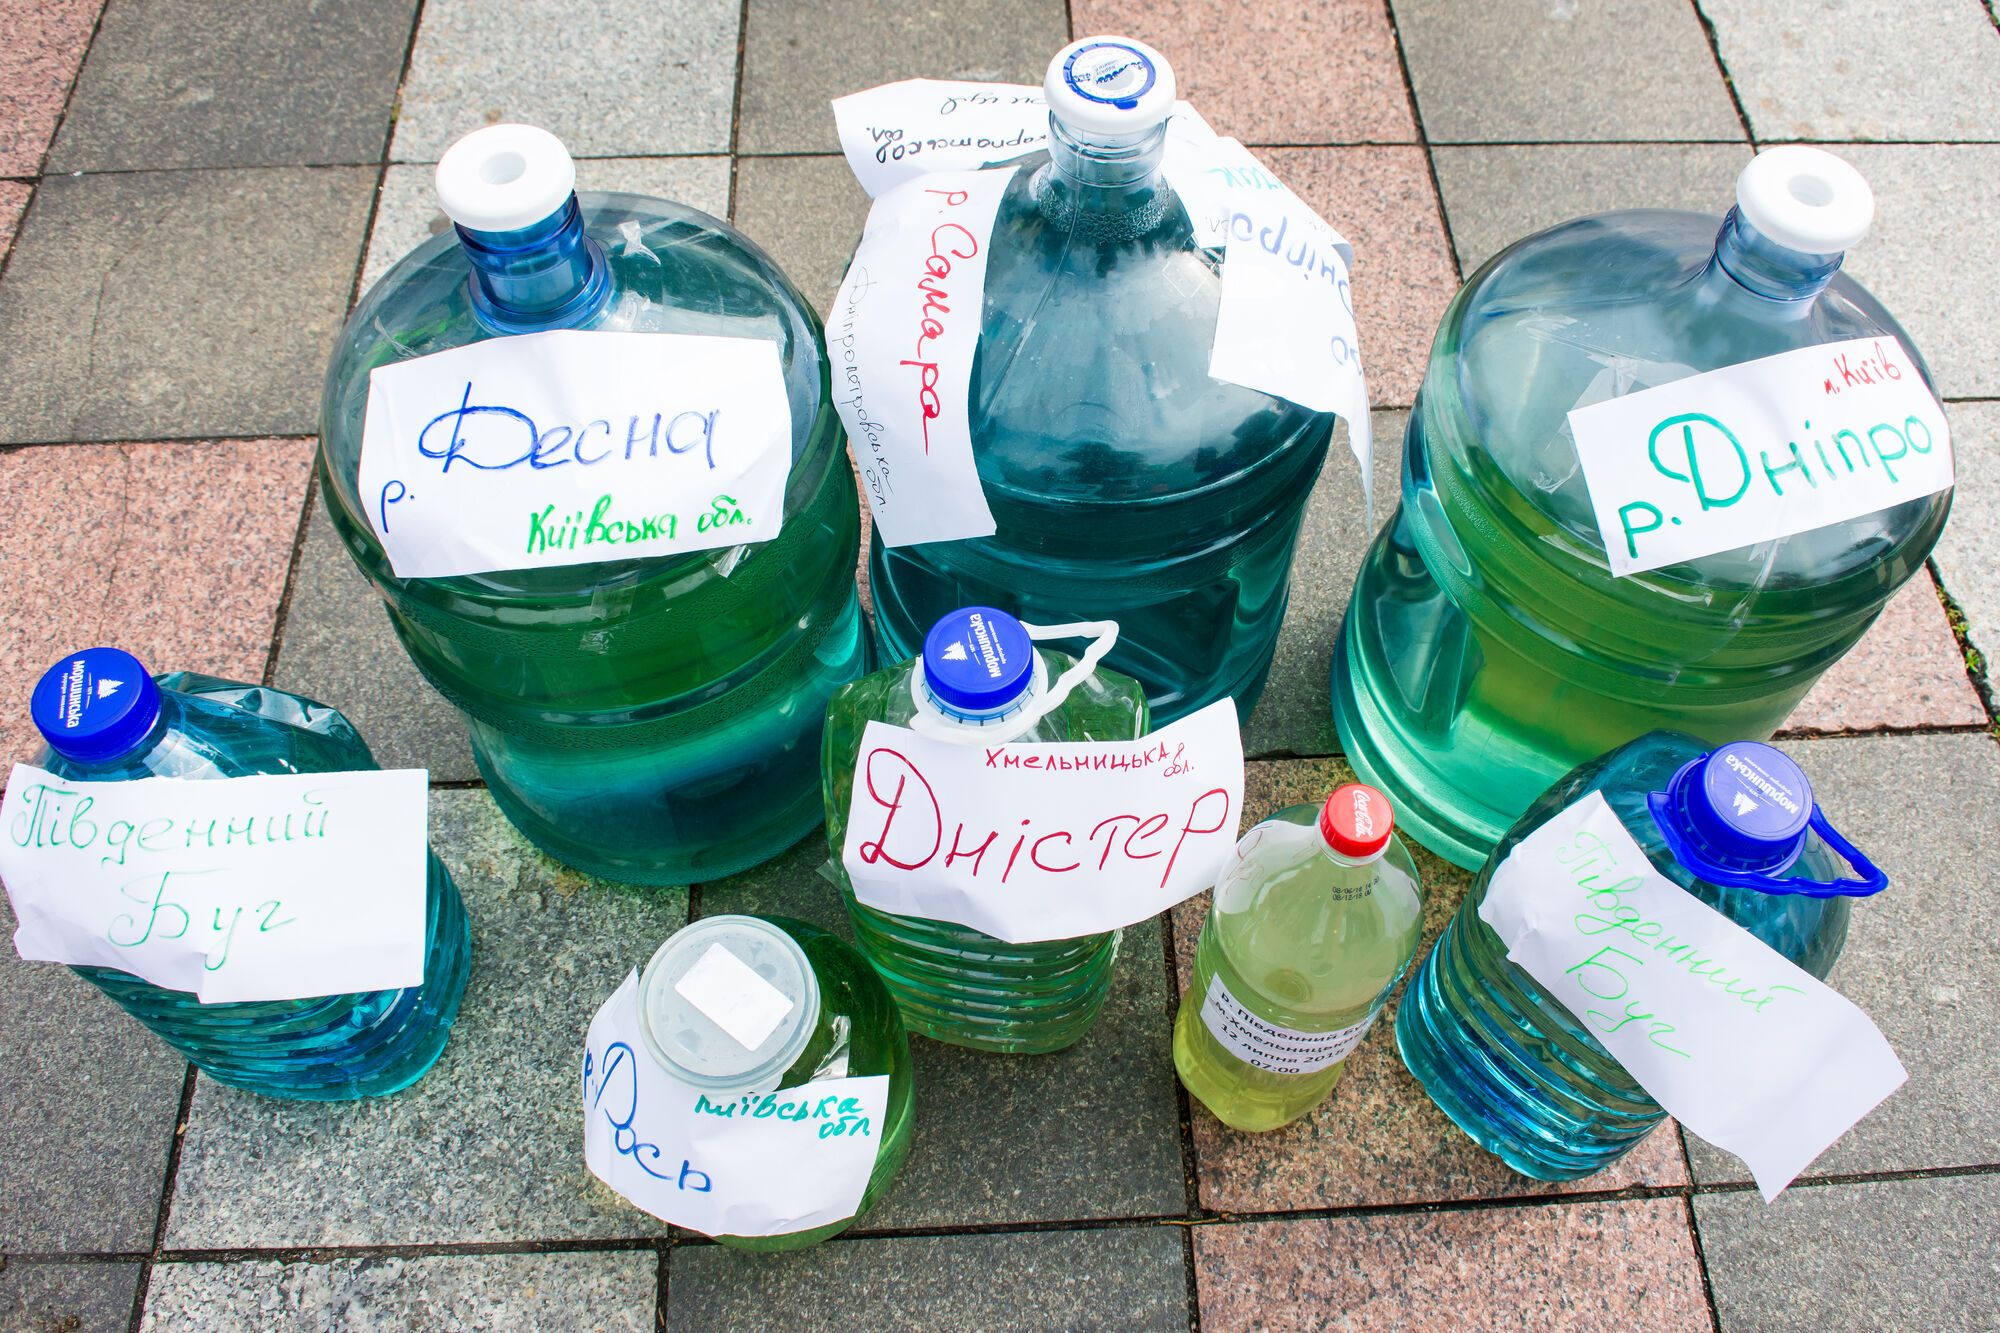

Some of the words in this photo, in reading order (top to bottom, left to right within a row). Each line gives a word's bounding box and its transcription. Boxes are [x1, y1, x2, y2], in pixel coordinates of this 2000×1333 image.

[891, 128, 1048, 161] карпатська
[899, 223, 979, 457] Самара
[1833, 340, 1902, 389] Київ
[418, 380, 722, 473] Десна
[1647, 412, 1933, 511] Дніпро
[526, 493, 679, 555] Київська
[696, 493, 754, 536] обл.
[9, 783, 345, 866] Південний
[106, 868, 298, 972] Буг
[1237, 1008, 1338, 1043] Південний
[1564, 946, 1691, 1058] Буг
[1220, 1023, 1239, 1042] 12
[1241, 1042, 1298, 1064] липня
[1250, 1058, 1301, 1074] 07:00
